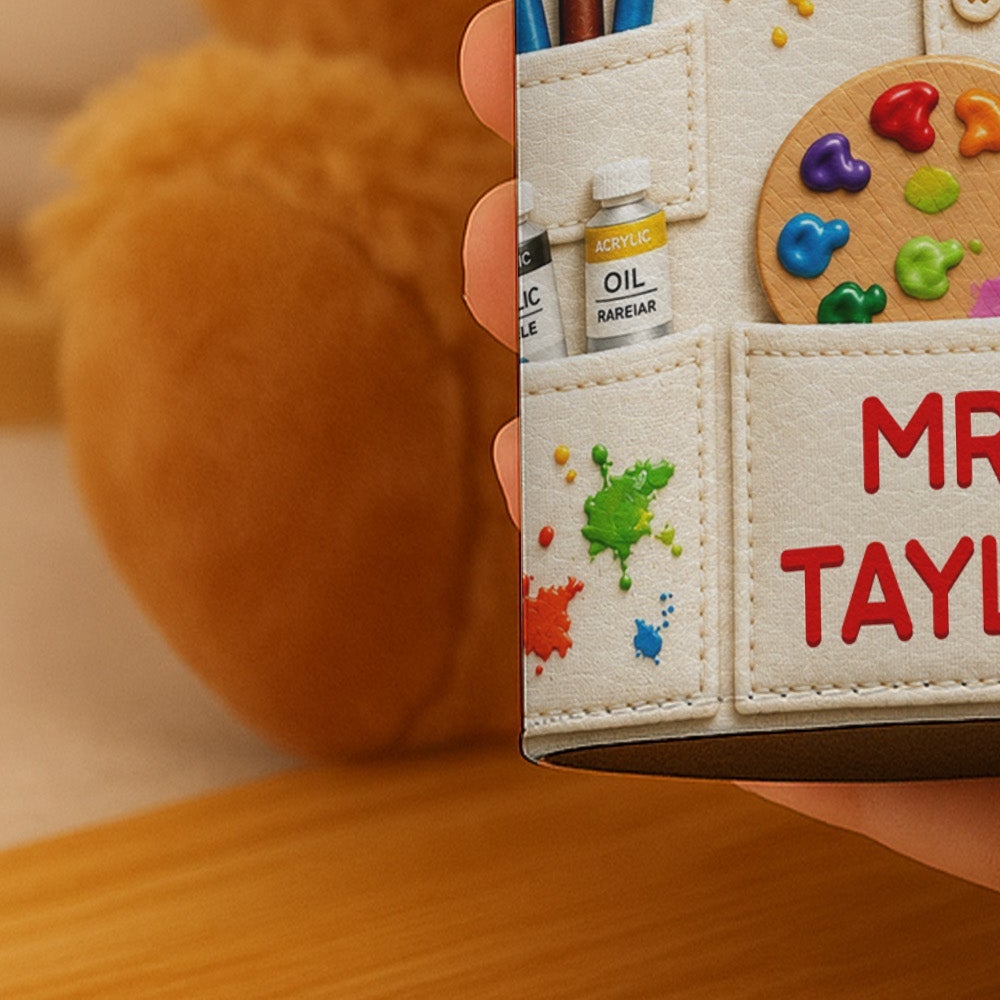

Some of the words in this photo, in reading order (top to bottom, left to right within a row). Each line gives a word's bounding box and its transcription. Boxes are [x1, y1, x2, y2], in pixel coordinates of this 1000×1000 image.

[595, 228, 652, 254] ACRYLIC
[603, 267, 646, 294] OIL
[597, 299, 657, 324] RAREIAR
